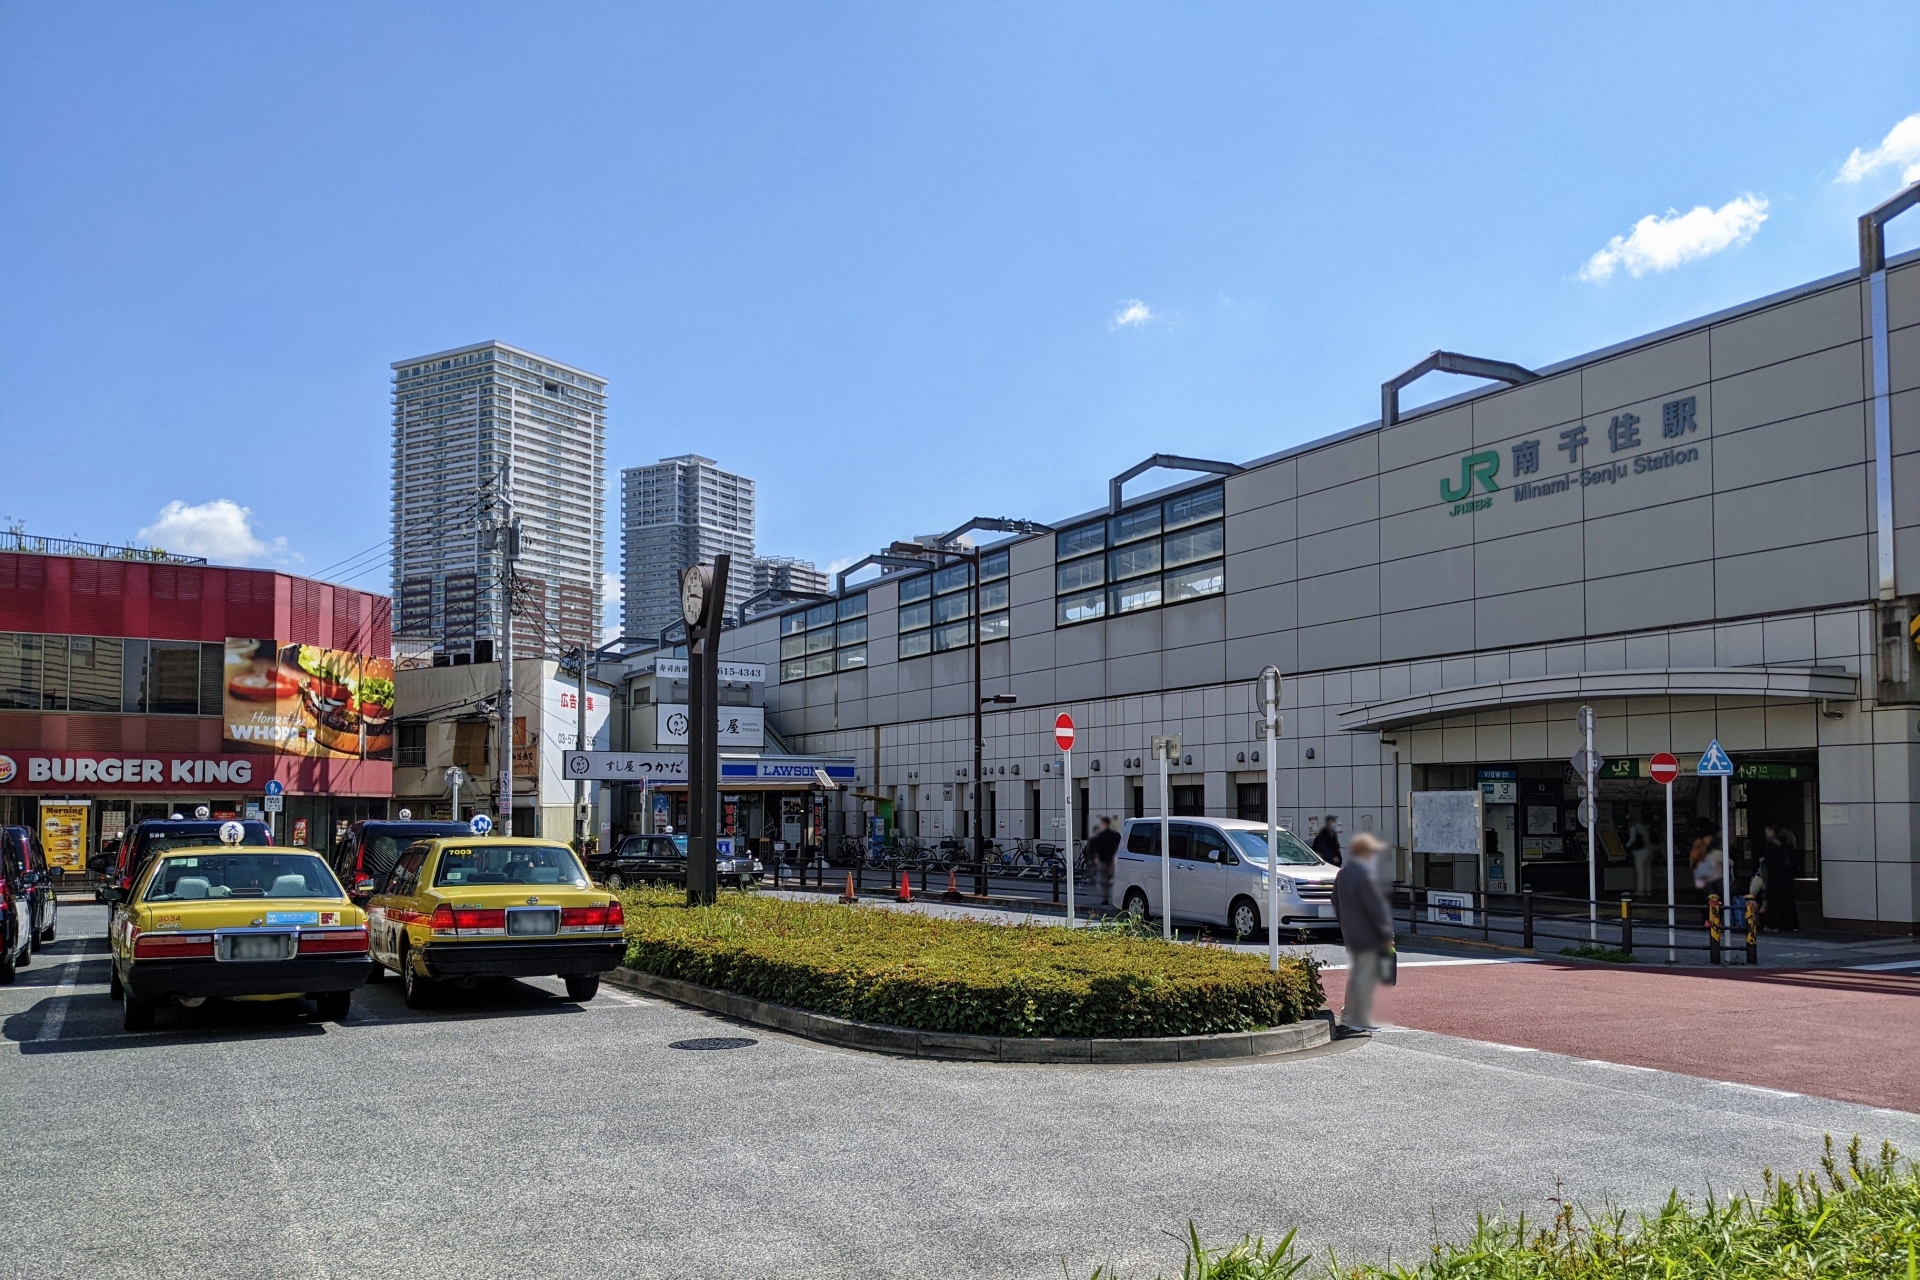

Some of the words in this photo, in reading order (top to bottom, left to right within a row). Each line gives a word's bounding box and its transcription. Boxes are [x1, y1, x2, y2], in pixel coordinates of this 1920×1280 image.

[1511, 396, 1696, 477] 南千住駅
[1440, 450, 1500, 503] JR
[1514, 462, 1628, 502] Minami-Senju
[1633, 448, 1698, 476] Station
[718, 667, 761, 677] 615-4343
[560, 692, 594, 711] 広告集
[251, 711, 281, 724] Home
[283, 710, 292, 726] of
[292, 711, 306, 726] the
[718, 719, 739, 734] し屋
[29, 757, 163, 782] BURGER
[172, 759, 252, 784] KING
[606, 760, 634, 772] すし屋
[638, 760, 684, 773] つかだ
[764, 765, 819, 776] LAWSON
[1612, 760, 1630, 772] JR
[1746, 766, 1756, 774] JR
[46, 807, 83, 815] Morning
[227, 824, 238, 841] 大和
[478, 821, 487, 829] N
